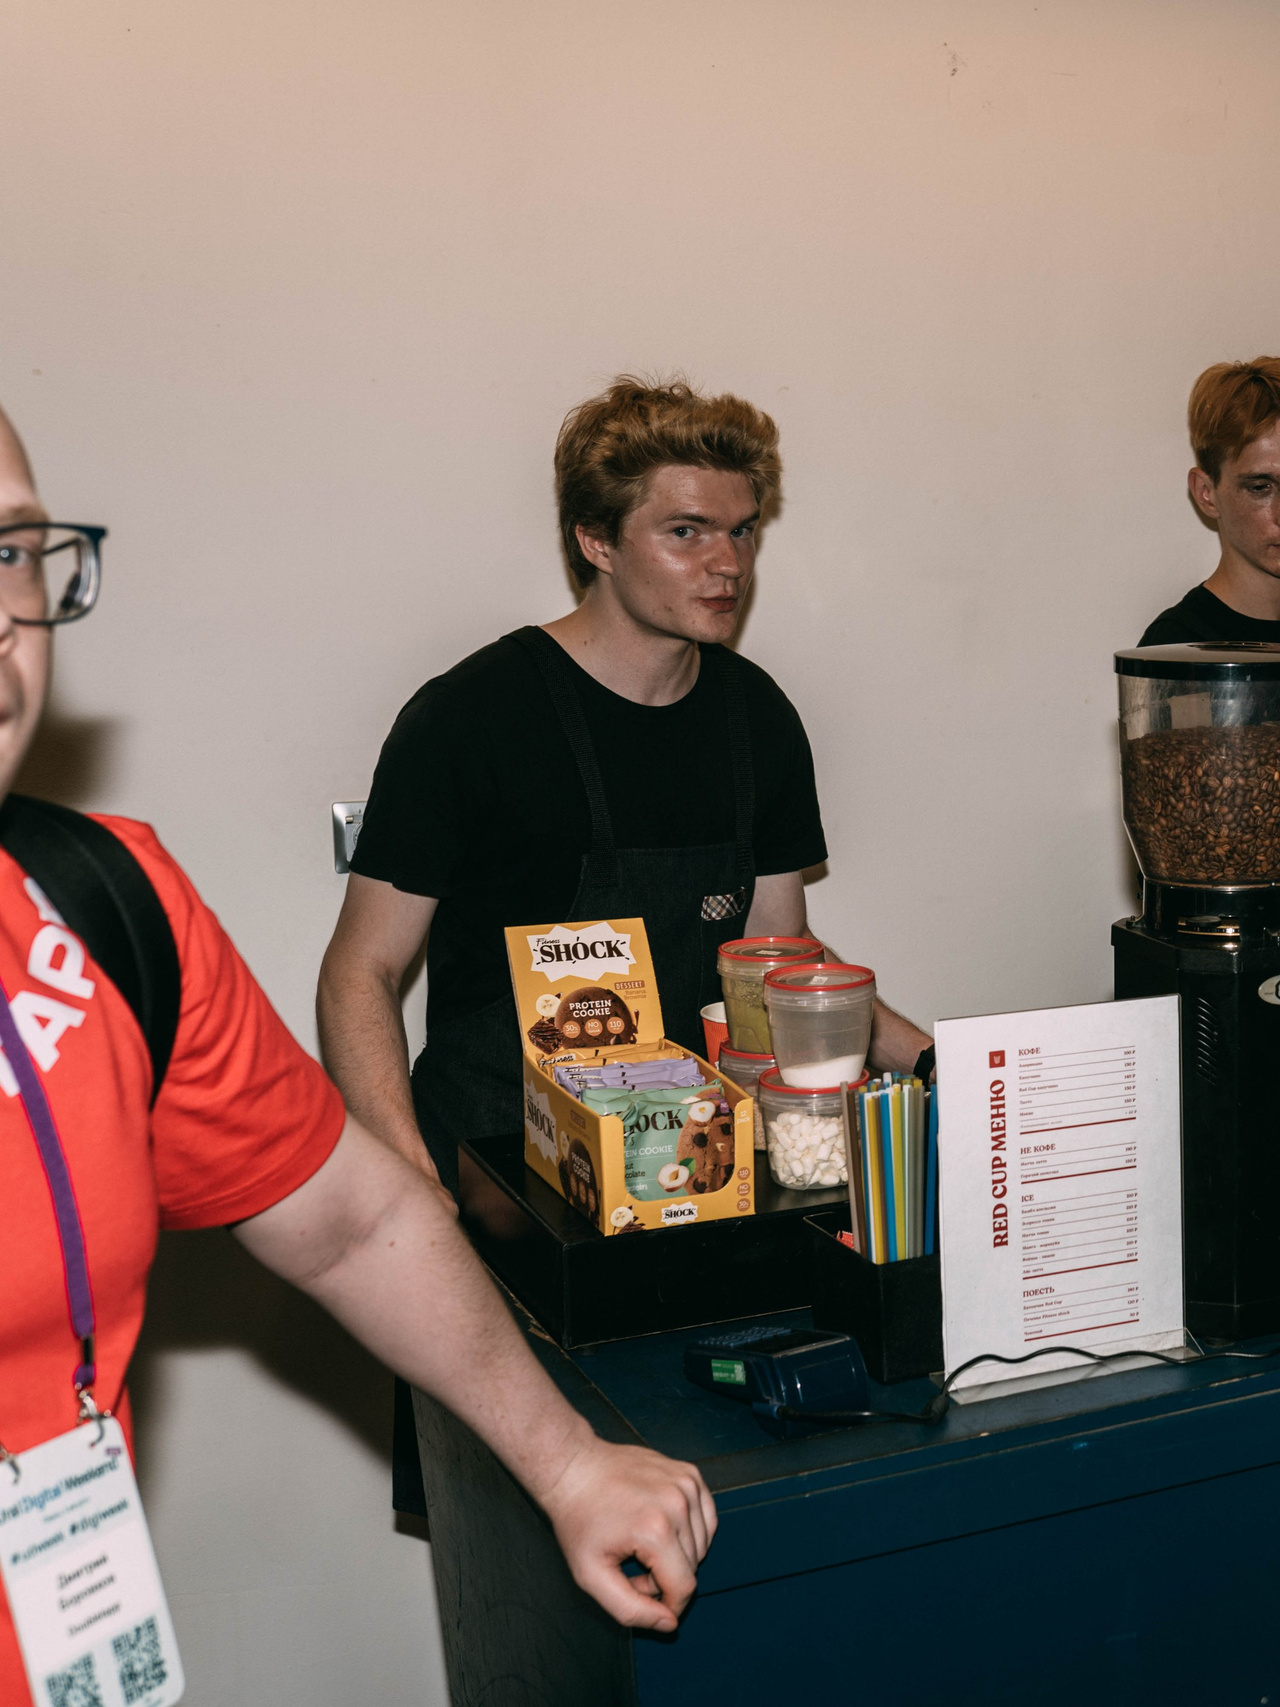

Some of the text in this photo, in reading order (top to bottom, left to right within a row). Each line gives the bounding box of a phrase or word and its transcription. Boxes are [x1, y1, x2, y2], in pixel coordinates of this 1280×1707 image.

[540, 940, 625, 963] SHOCK
[615, 981, 642, 989] DESSERT
[569, 1000, 612, 1010] PROTEIN
[572, 1008, 611, 1017] COOKIE
[1018, 1047, 1041, 1056] КОФЕ
[526, 1098, 555, 1143] SHOCK
[624, 1109, 683, 1134] OCK
[639, 1145, 673, 1155] COOKIE
[1034, 1144, 1056, 1152] КОФЕ
[990, 1079, 1008, 1248] RED CUP МЕНЮ
[1021, 1194, 1034, 1202] ICE
[664, 1208, 694, 1219] SHOCK
[1023, 1287, 1055, 1298] ПОЕСТЬ
